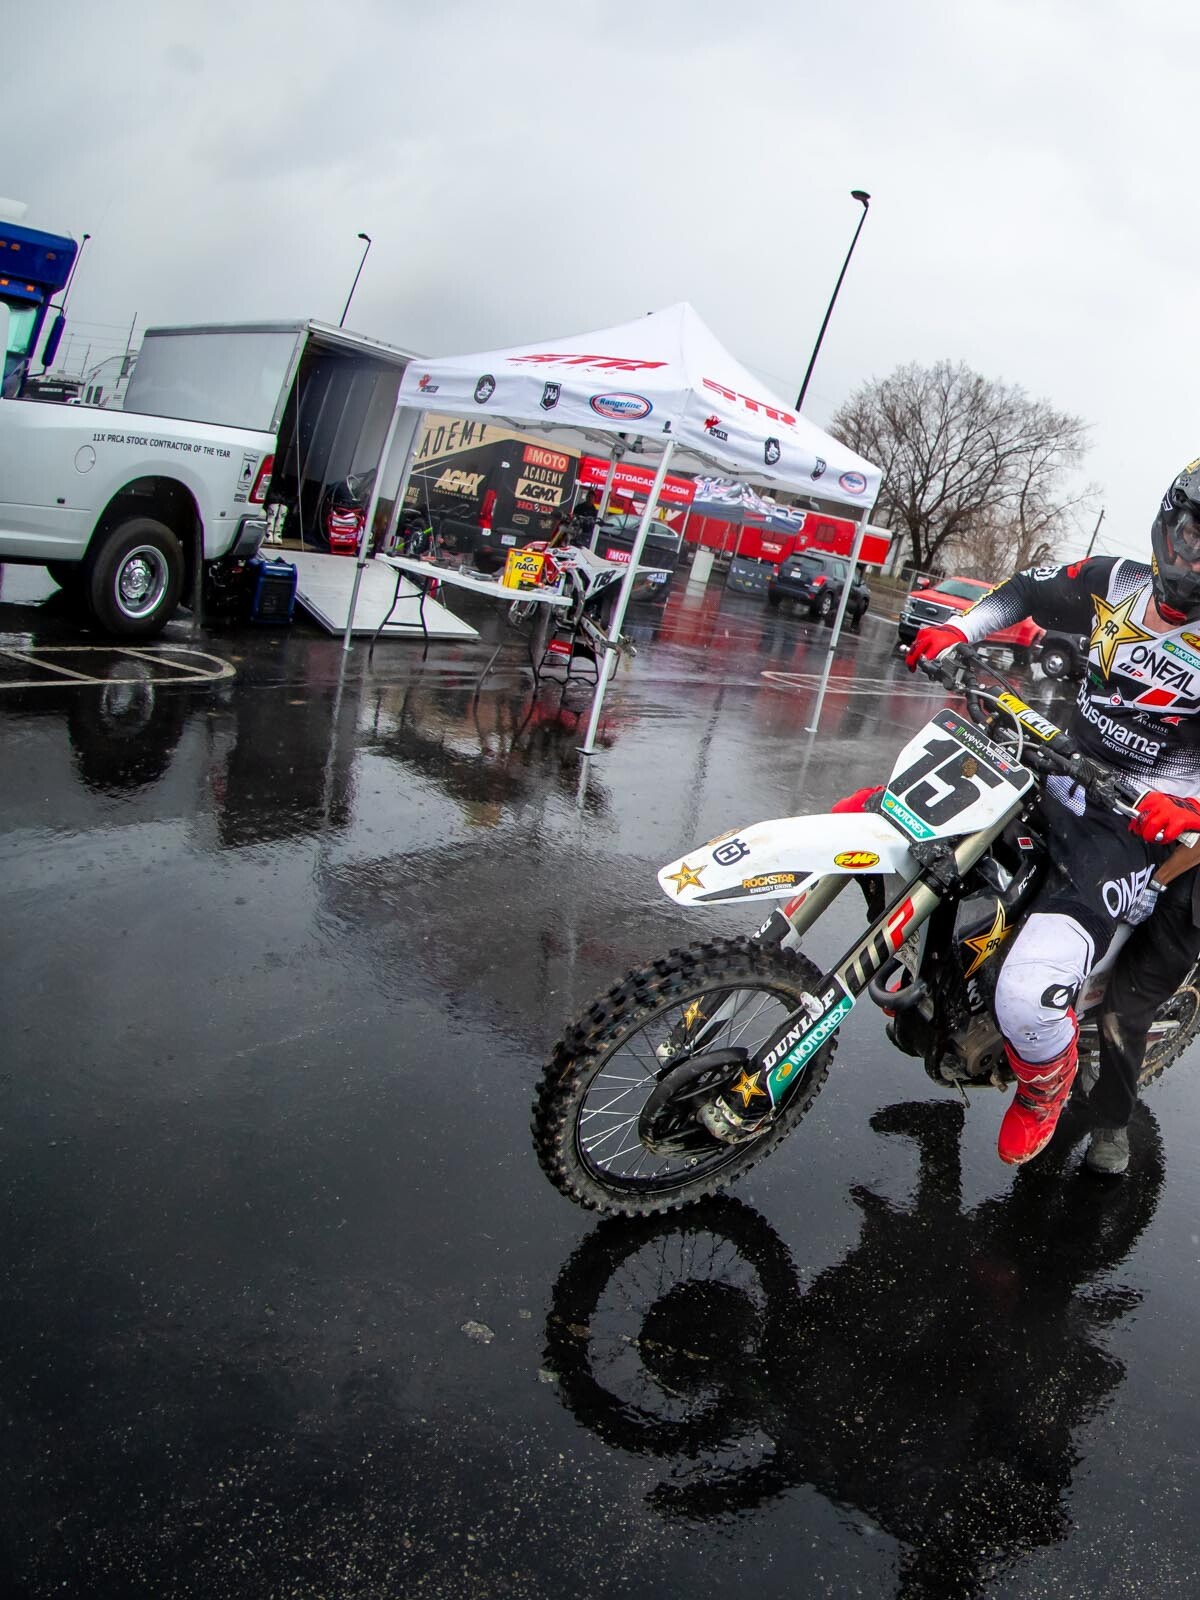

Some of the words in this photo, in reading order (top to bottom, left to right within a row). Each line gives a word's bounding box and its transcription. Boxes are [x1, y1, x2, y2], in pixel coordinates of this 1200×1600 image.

[600, 397, 642, 411] Rangeline
[92, 433, 105, 442] 11X
[107, 434, 125, 444] PRCA
[126, 436, 148, 446] STOCK
[149, 439, 192, 452] CONTRACTOR
[193, 445, 202, 453] OF
[203, 446, 215, 456] THE
[216, 449, 231, 458] YEAR
[533, 450, 566, 469] MOTO
[523, 465, 564, 486] ACADEMY
[520, 483, 558, 503] AGMX
[515, 562, 540, 572] RAGS
[1077, 690, 1161, 757] Husqvarna
[1102, 738, 1129, 756] FACTORY
[1129, 751, 1154, 765] RACING
[888, 738, 1005, 827] 15
[893, 804, 926, 837] MOTOREX
[834, 853, 880, 867] FMF
[742, 873, 795, 889] ROCKSTAR
[750, 886, 774, 894] ENERGY
[774, 883, 792, 891] DRINK
[761, 988, 836, 1072] DUNLP
[789, 1004, 850, 1065] MOTOREX
